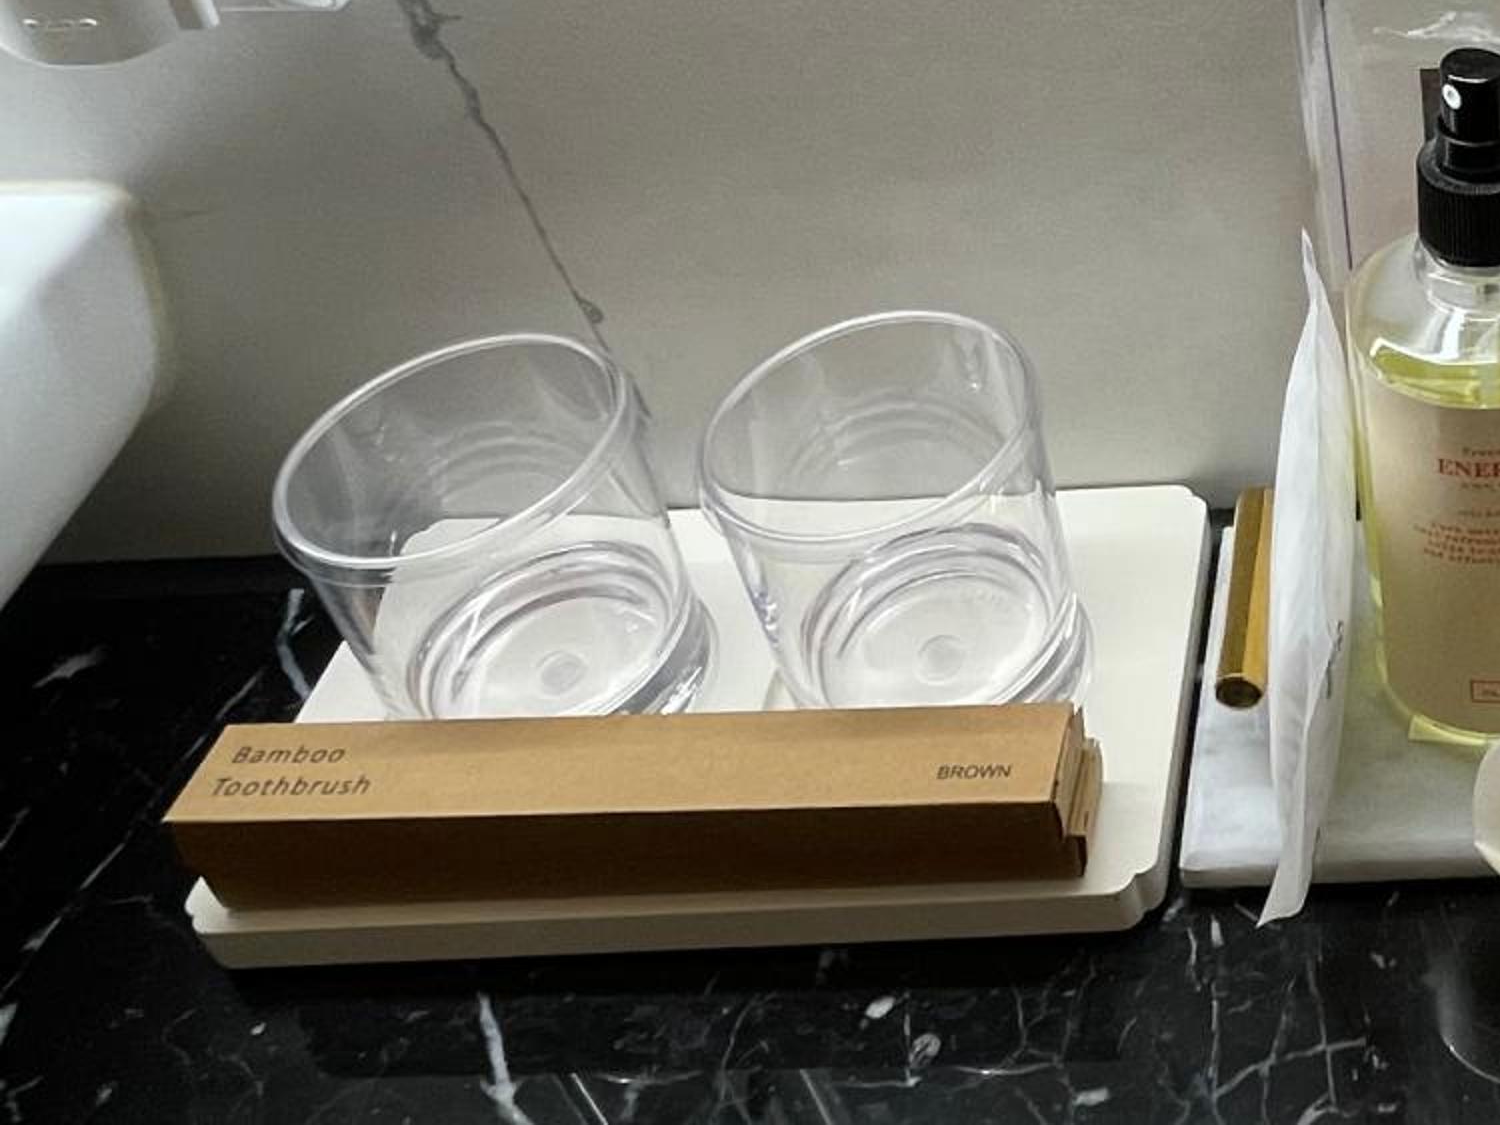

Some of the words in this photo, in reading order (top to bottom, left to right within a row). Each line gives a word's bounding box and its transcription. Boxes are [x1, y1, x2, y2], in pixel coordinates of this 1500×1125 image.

[231, 745, 346, 765] Bamboo
[936, 764, 1012, 780] BROWN
[211, 774, 372, 797] Toothbrush
